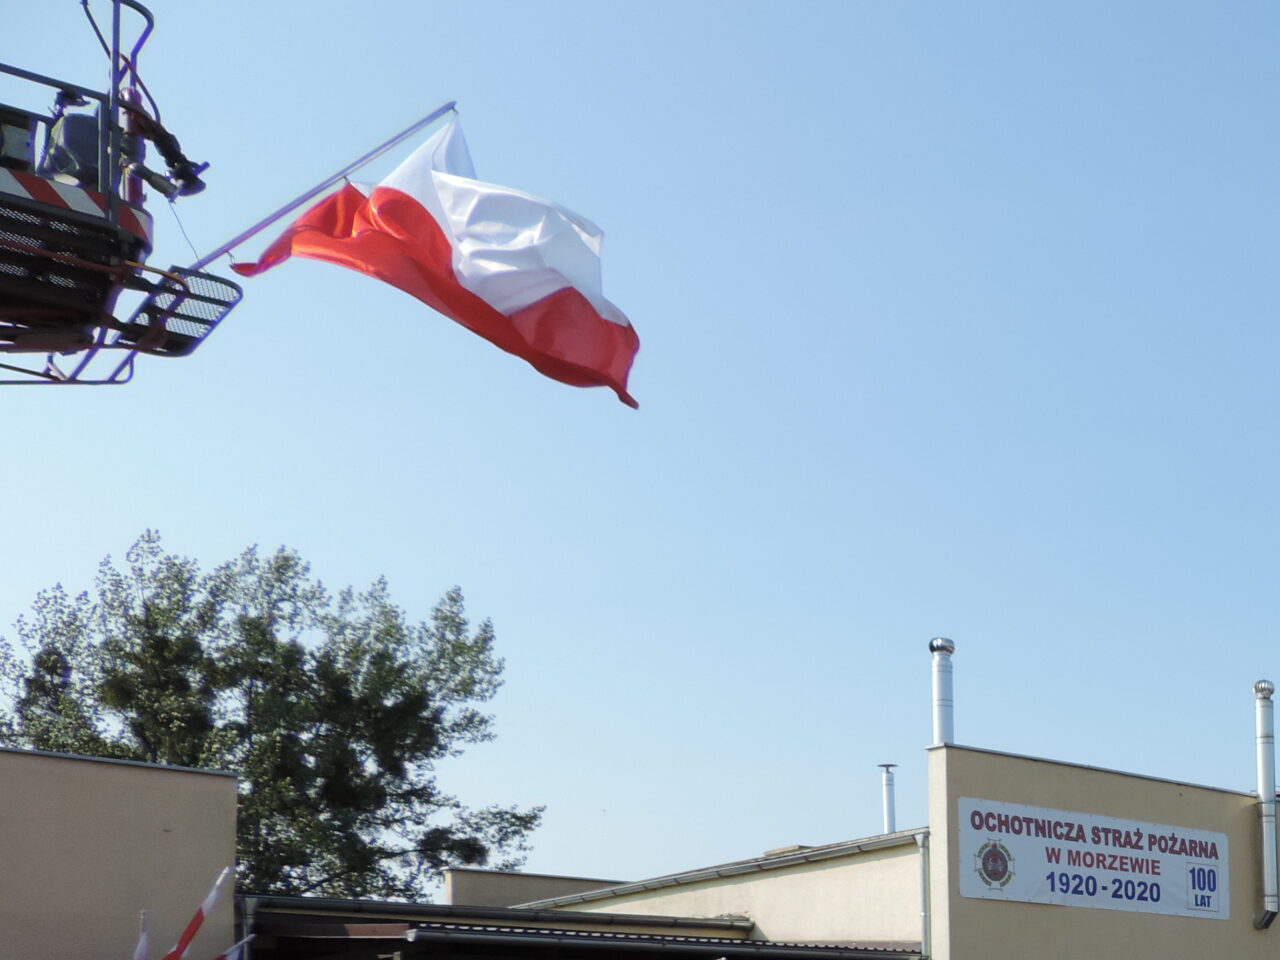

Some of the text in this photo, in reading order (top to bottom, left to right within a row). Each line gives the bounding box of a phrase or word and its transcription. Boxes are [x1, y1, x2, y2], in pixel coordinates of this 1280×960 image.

[969, 810, 1219, 860] OCHOTNICZA STRAŻ POŻARNA
[1045, 847, 1161, 875] W MORZEWIE
[1189, 867, 1217, 892] 100
[1195, 895, 1212, 908] LAT
